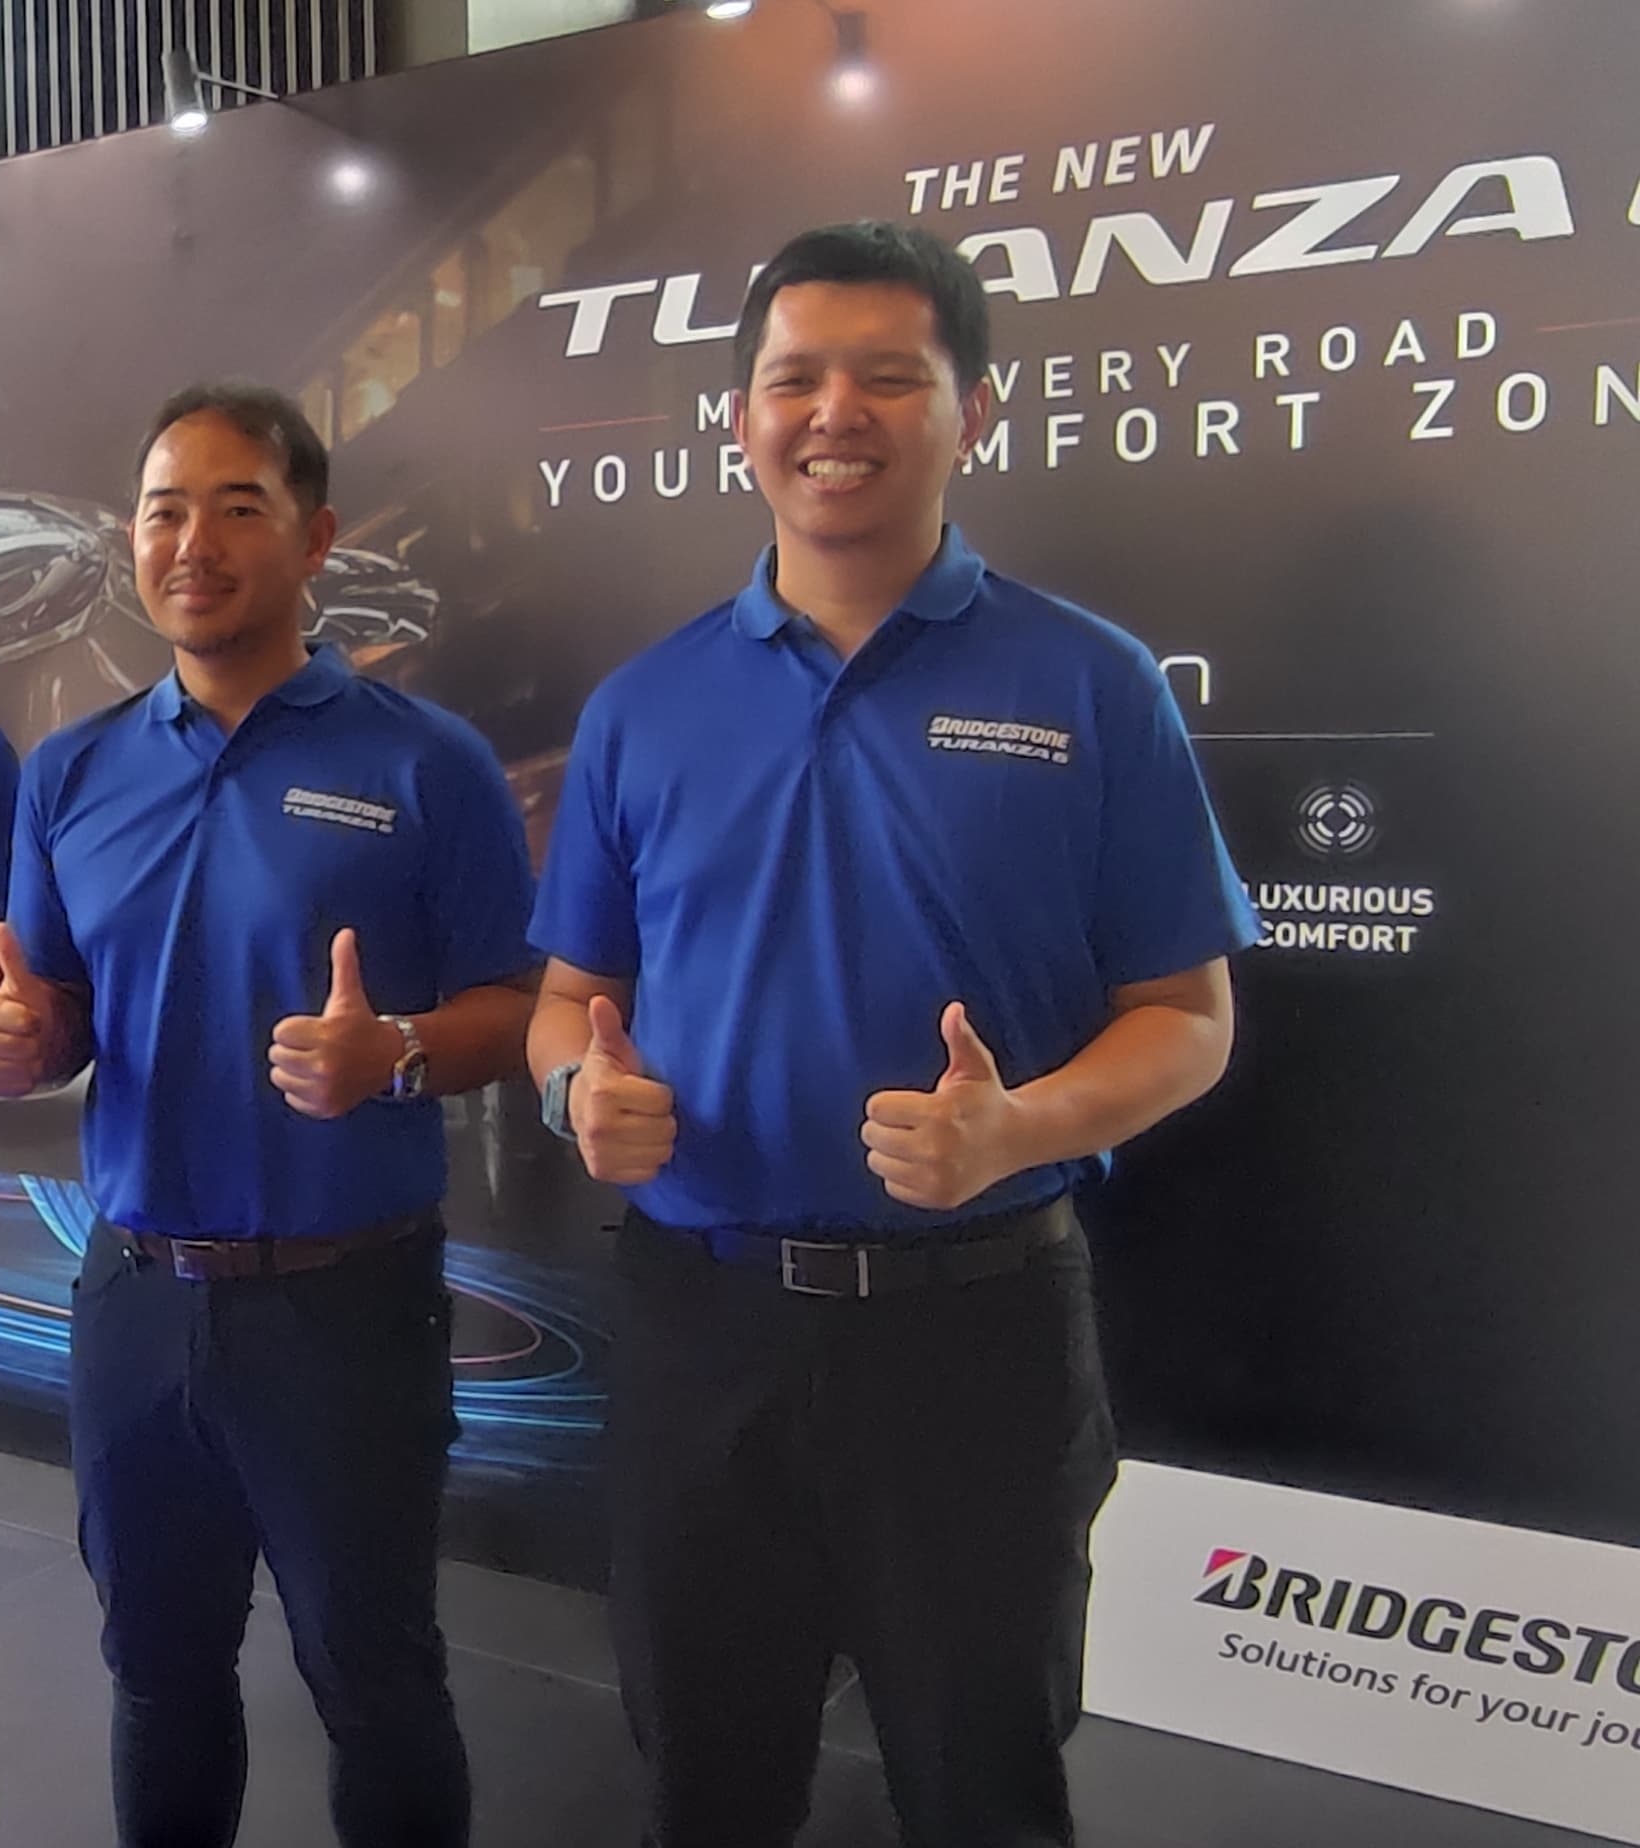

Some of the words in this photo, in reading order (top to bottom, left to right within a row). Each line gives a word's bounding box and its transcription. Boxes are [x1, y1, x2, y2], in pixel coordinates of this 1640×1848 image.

[905, 155, 1024, 214] THE
[1053, 124, 1215, 194] NEW
[538, 155, 1575, 358] TUANZA
[988, 342, 1191, 403] VERY
[1254, 311, 1497, 380] ROAD
[539, 444, 754, 507] YOUR
[961, 392, 1321, 475] MFORT
[927, 736, 1050, 760] TURANZA
[928, 715, 1071, 749] BRIDGESTONE
[1255, 920, 1418, 954] COMFORT
[1217, 1632, 1399, 1696] Solutions
[1409, 1673, 1472, 1711] for
[1475, 1693, 1580, 1734] your
